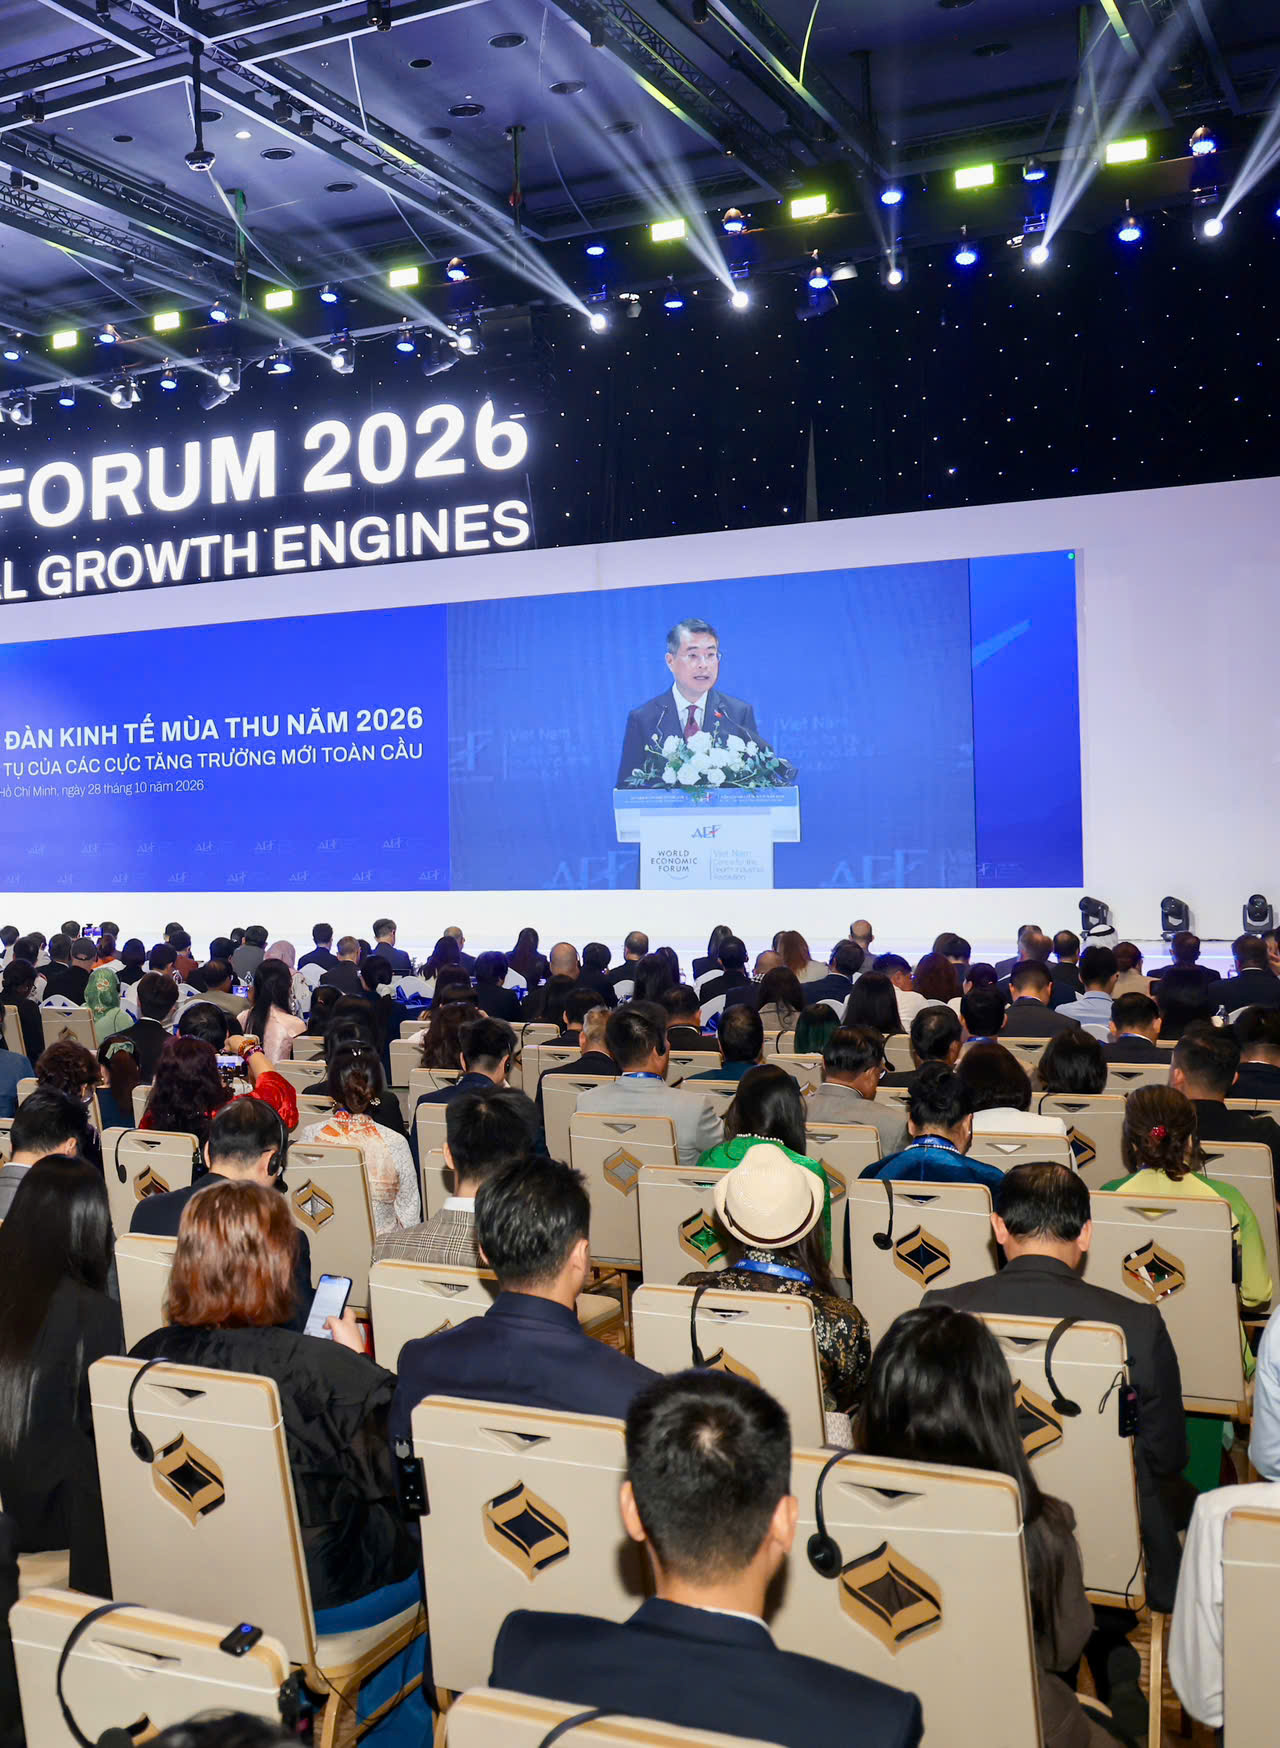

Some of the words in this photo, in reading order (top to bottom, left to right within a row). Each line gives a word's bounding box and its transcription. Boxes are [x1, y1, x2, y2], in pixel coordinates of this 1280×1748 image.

[303, 399, 528, 493] 2026
[38, 531, 256, 596] GROWTH
[273, 500, 530, 570] ENGINES
[4, 725, 53, 750] ĐÀN
[60, 724, 117, 748] KINH
[124, 713, 155, 744] TẾ
[162, 715, 219, 742] MÙA
[224, 715, 279, 739] THU
[287, 707, 349, 736] NĂM
[356, 706, 424, 732] 2026
[3, 762, 24, 780] TỤ
[28, 757, 63, 776] CỦA
[65, 755, 101, 774] CÁC
[104, 753, 141, 776] CỰC
[145, 752, 193, 771] TĂNG
[197, 747, 276, 769] TRƯỞNG
[281, 744, 317, 766] MỚI
[321, 742, 376, 763] TOÀN
[380, 736, 423, 761] CẦU
[13, 785, 31, 798] Chí
[61, 784, 86, 798] ngày
[87, 783, 102, 794] 28
[103, 782, 133, 797] tháng
[134, 782, 148, 793] 10
[149, 781, 174, 793] năm
[176, 779, 205, 792] 2026
[650, 857, 698, 865] ECONOMIC
[658, 865, 690, 873] FORUM
